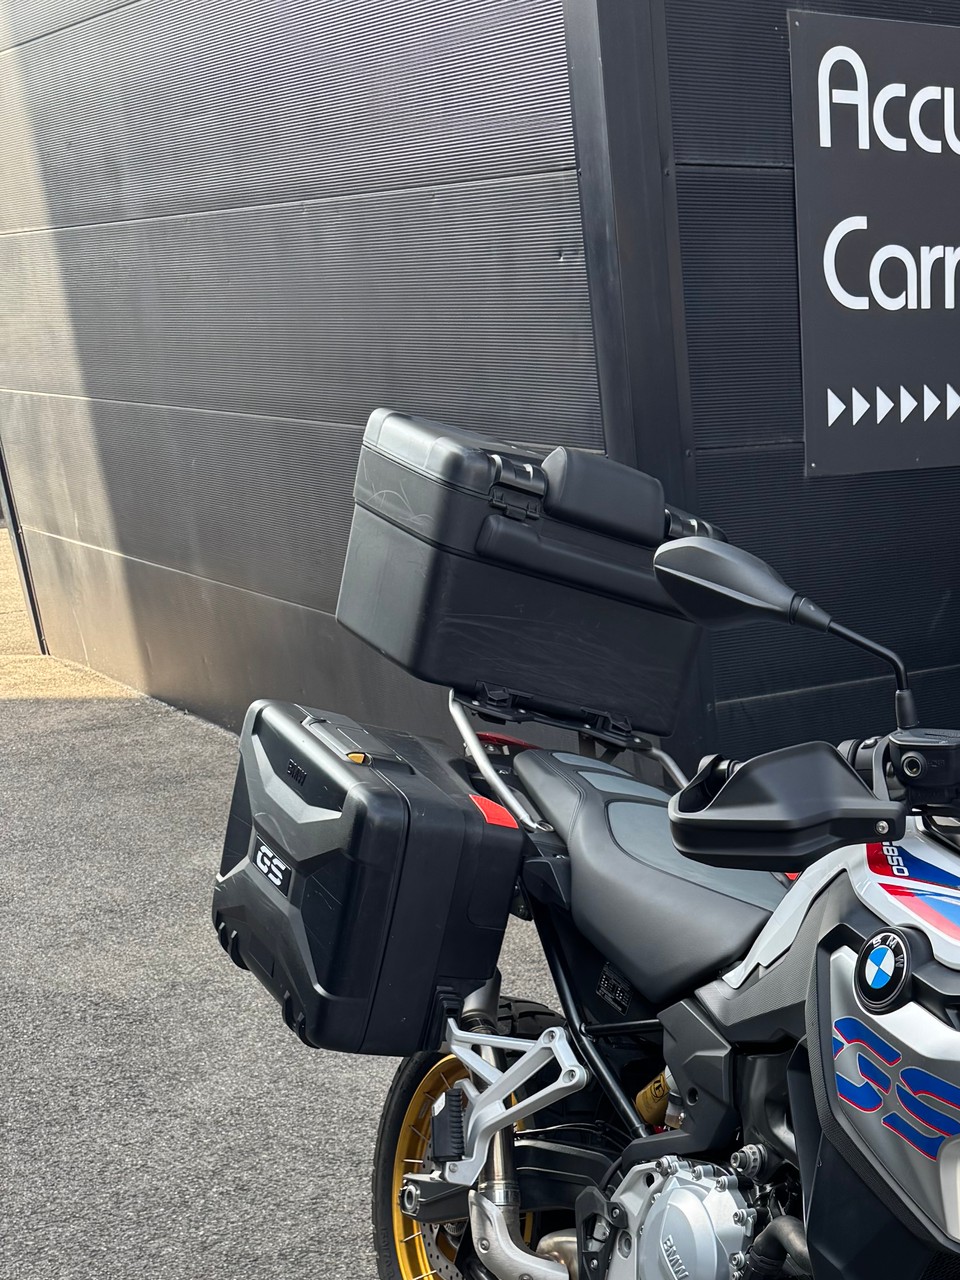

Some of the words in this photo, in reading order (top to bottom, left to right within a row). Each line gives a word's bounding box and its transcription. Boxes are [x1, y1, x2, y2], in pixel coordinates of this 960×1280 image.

[256, 845, 287, 886] GS
[872, 935, 904, 968] BMW
[663, 1234, 690, 1280] BMW
